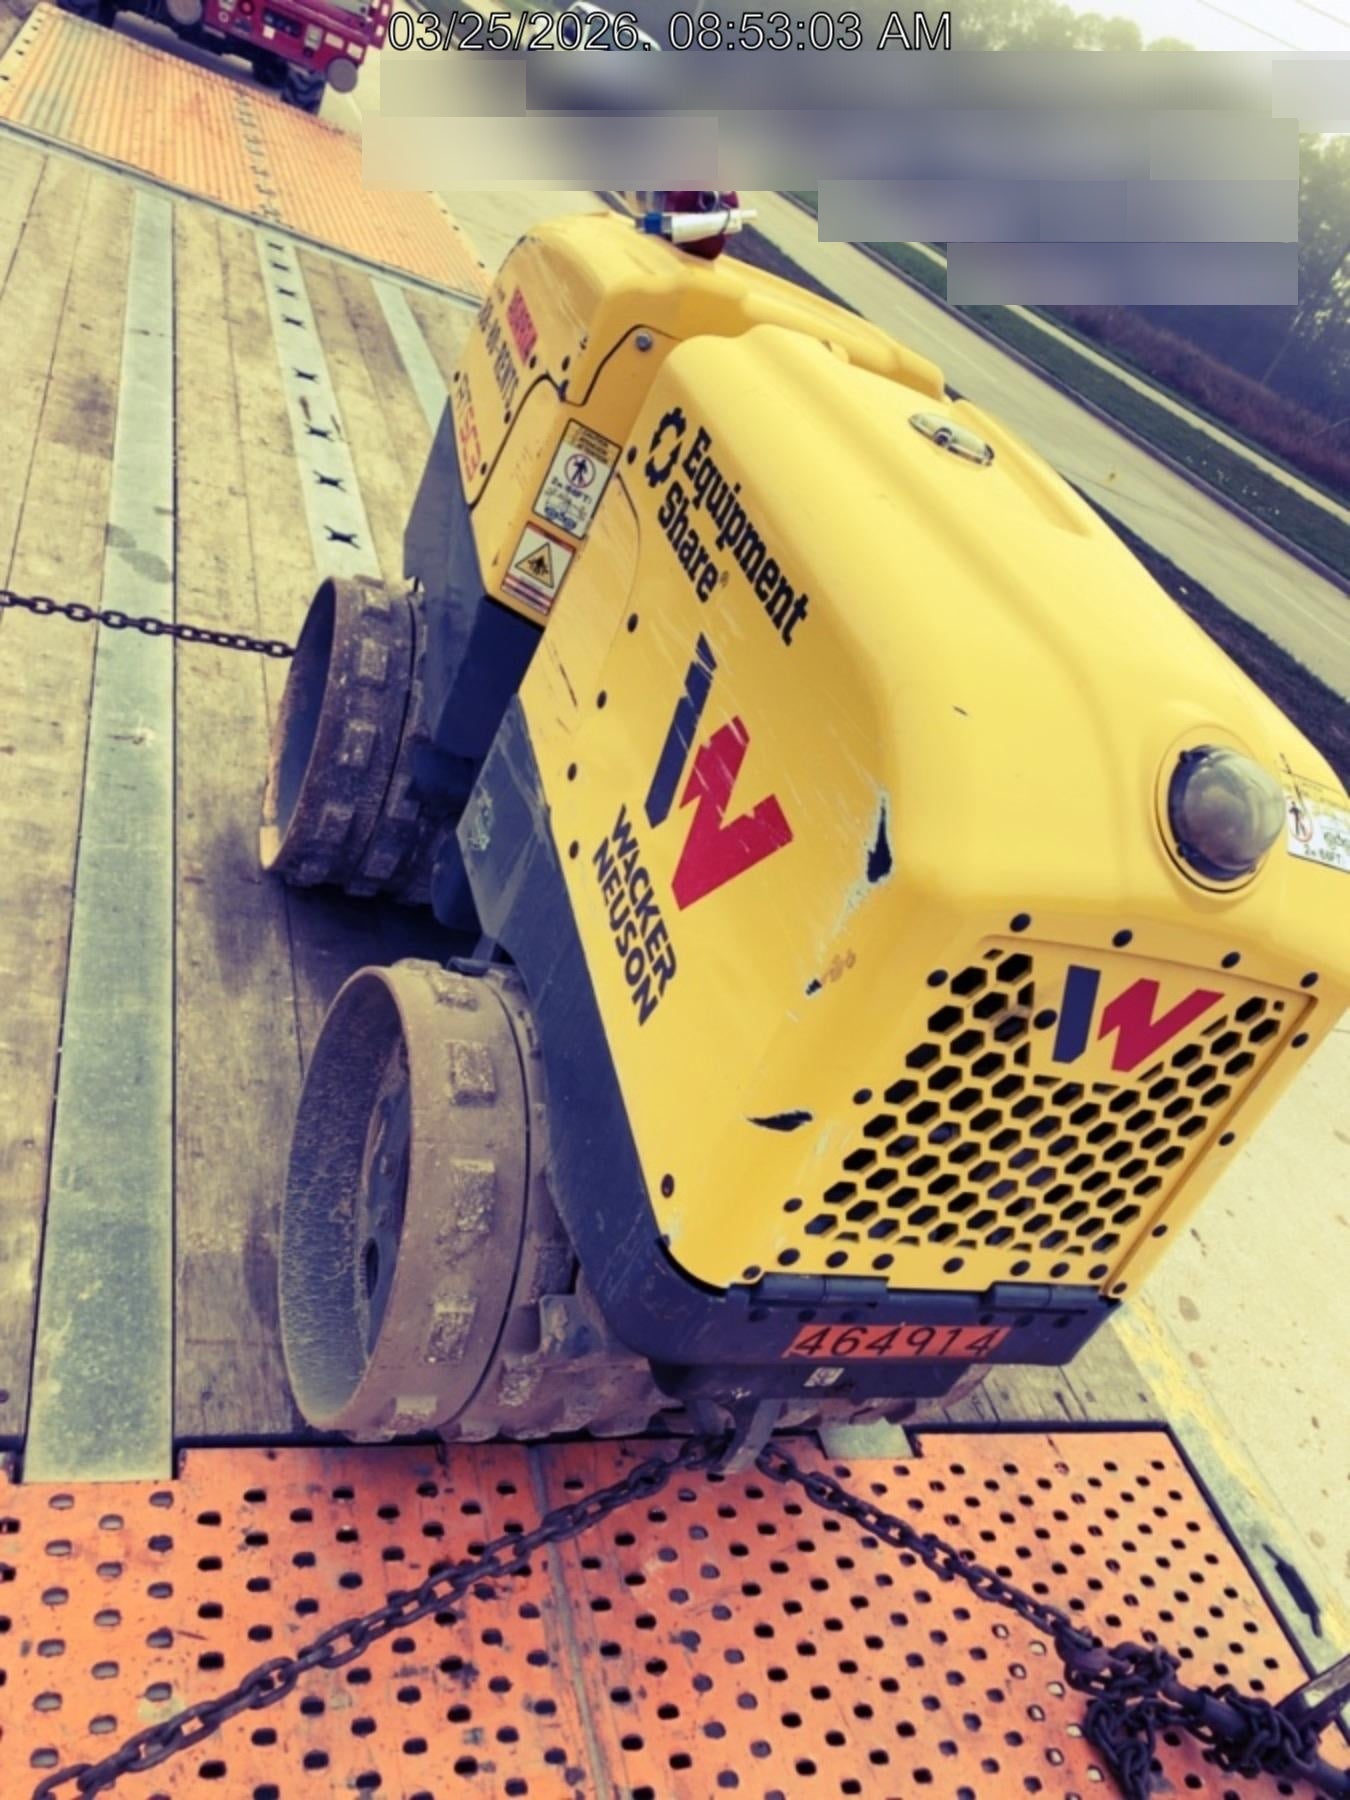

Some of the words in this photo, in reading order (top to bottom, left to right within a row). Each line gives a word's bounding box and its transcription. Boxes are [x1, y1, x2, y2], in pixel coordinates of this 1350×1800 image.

[682, 425, 809, 647] Equipment
[592, 836, 659, 1028] NEUSON
[611, 803, 678, 998] WACKER
[794, 1326, 1001, 1356] 464914
